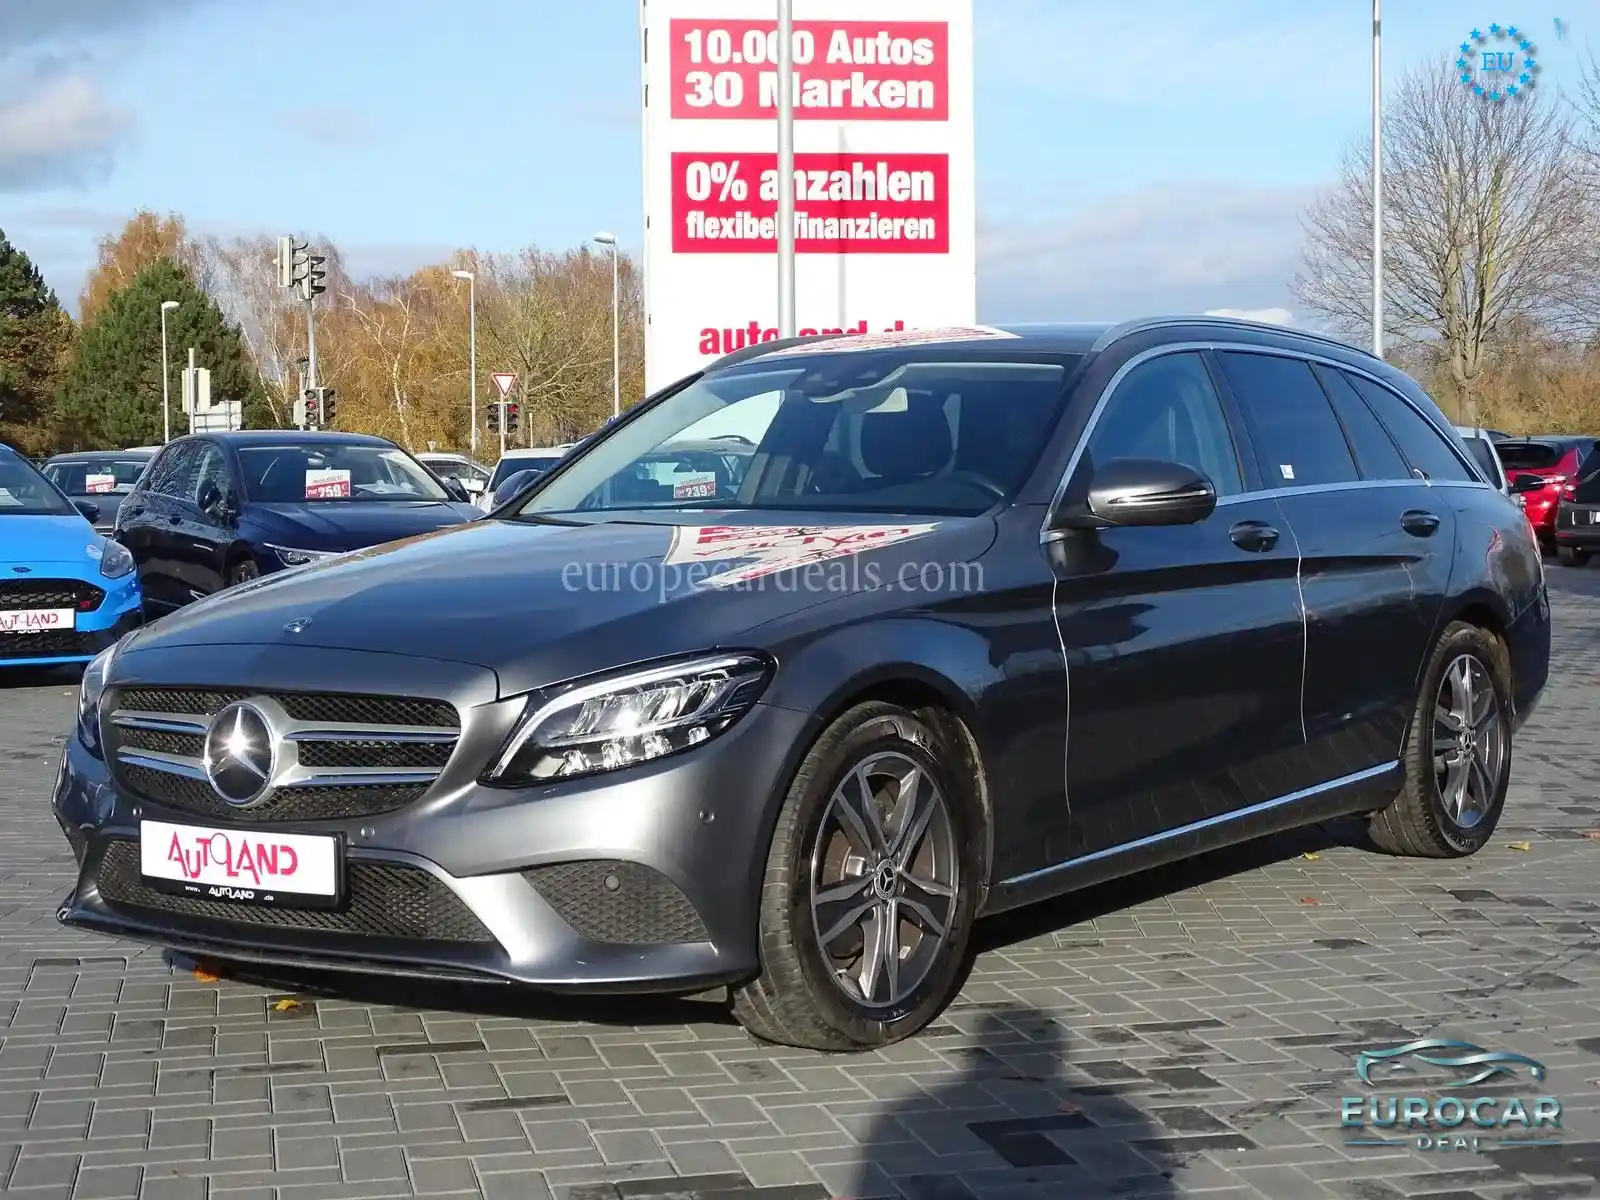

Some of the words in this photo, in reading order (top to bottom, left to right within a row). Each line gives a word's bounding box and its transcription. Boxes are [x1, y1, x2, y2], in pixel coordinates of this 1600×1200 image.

[826, 29, 935, 66] Autos
[684, 71, 744, 108] 30
[758, 71, 935, 109] Marken
[686, 160, 748, 202] 0%
[760, 161, 935, 202] anzahlen
[168, 831, 298, 885] AUTOLAND
